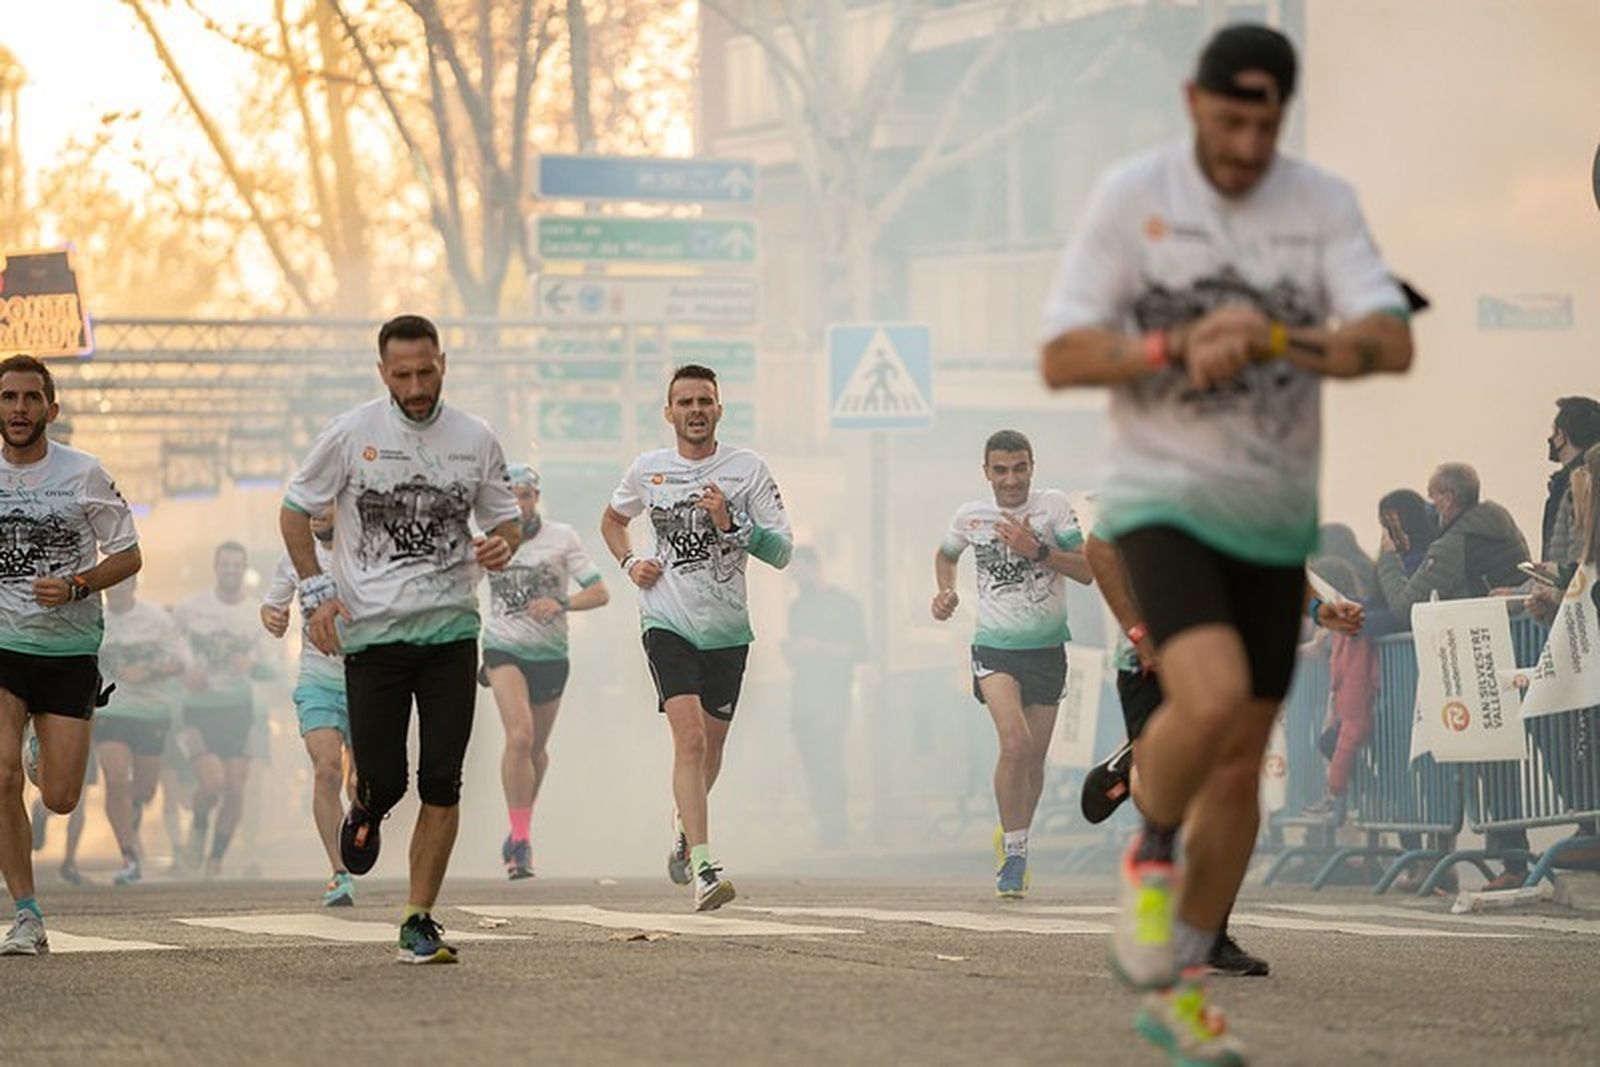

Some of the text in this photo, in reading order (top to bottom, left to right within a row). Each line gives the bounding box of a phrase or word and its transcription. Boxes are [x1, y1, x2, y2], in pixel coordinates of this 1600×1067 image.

[1469, 627, 1493, 729] SAN SILVESTRE
[1485, 651, 1504, 729] VALLECANA
